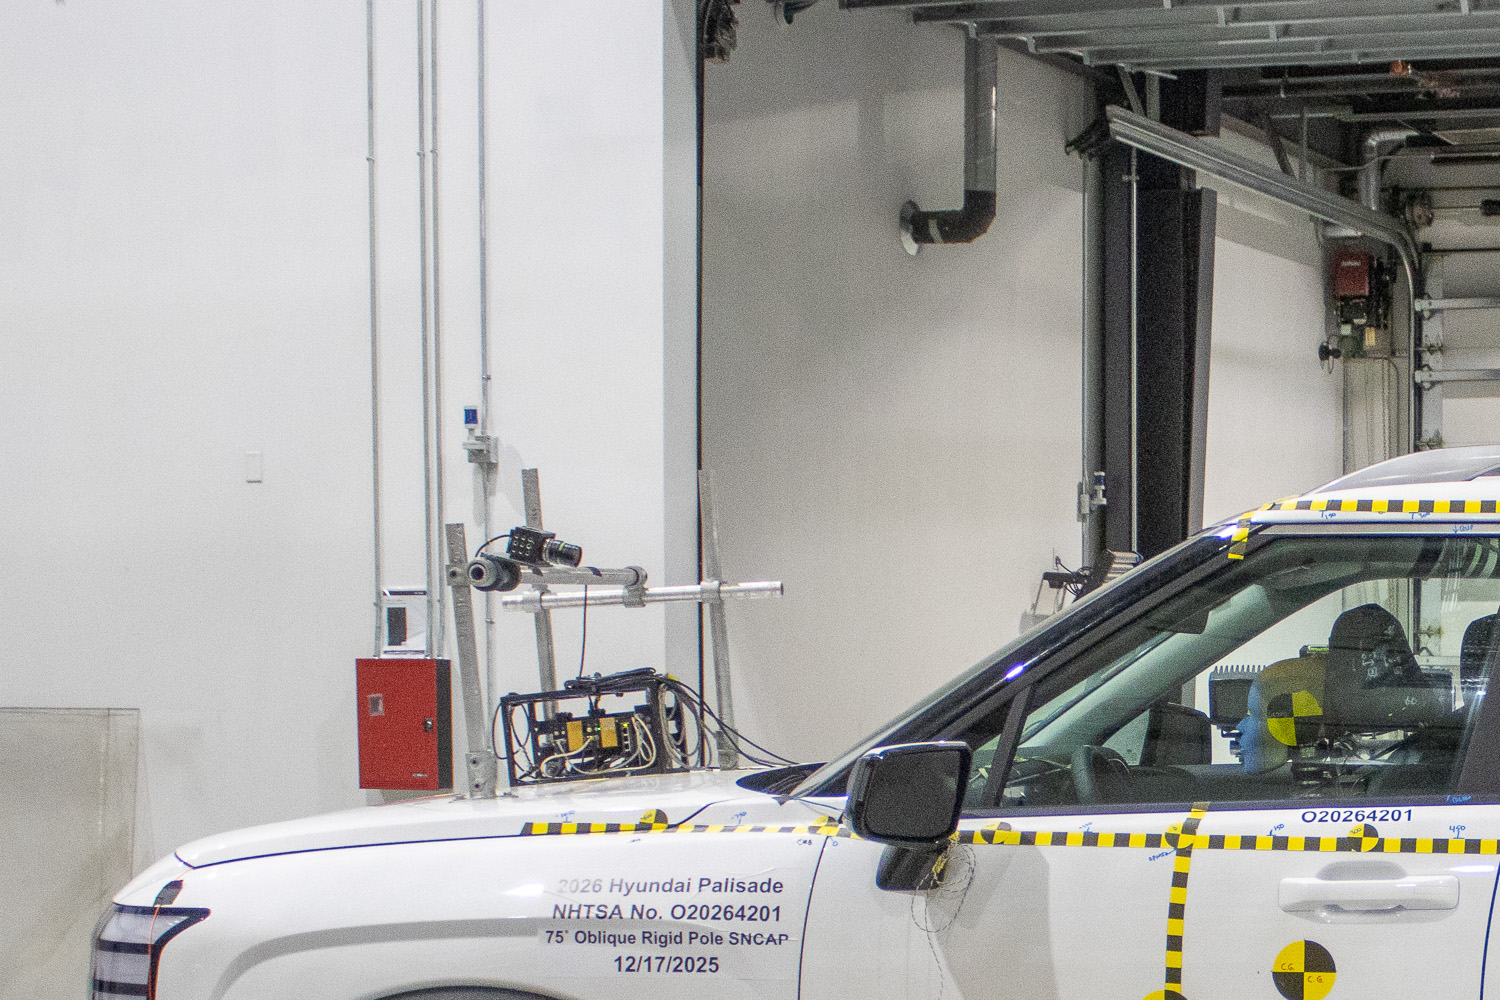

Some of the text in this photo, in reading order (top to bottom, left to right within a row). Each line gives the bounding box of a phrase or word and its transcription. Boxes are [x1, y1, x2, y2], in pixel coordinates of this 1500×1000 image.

[1301, 809, 1412, 823] O20264201
[558, 878, 784, 897] 2026 Hyundai Palisade
[552, 904, 781, 922] NHTSA No. O20264201
[575, 931, 636, 947] Oblique
[642, 931, 683, 947] Rigid
[689, 932, 723, 945] Pole
[729, 933, 789, 946] SNCAP
[613, 956, 719, 973] 12/17/2025
